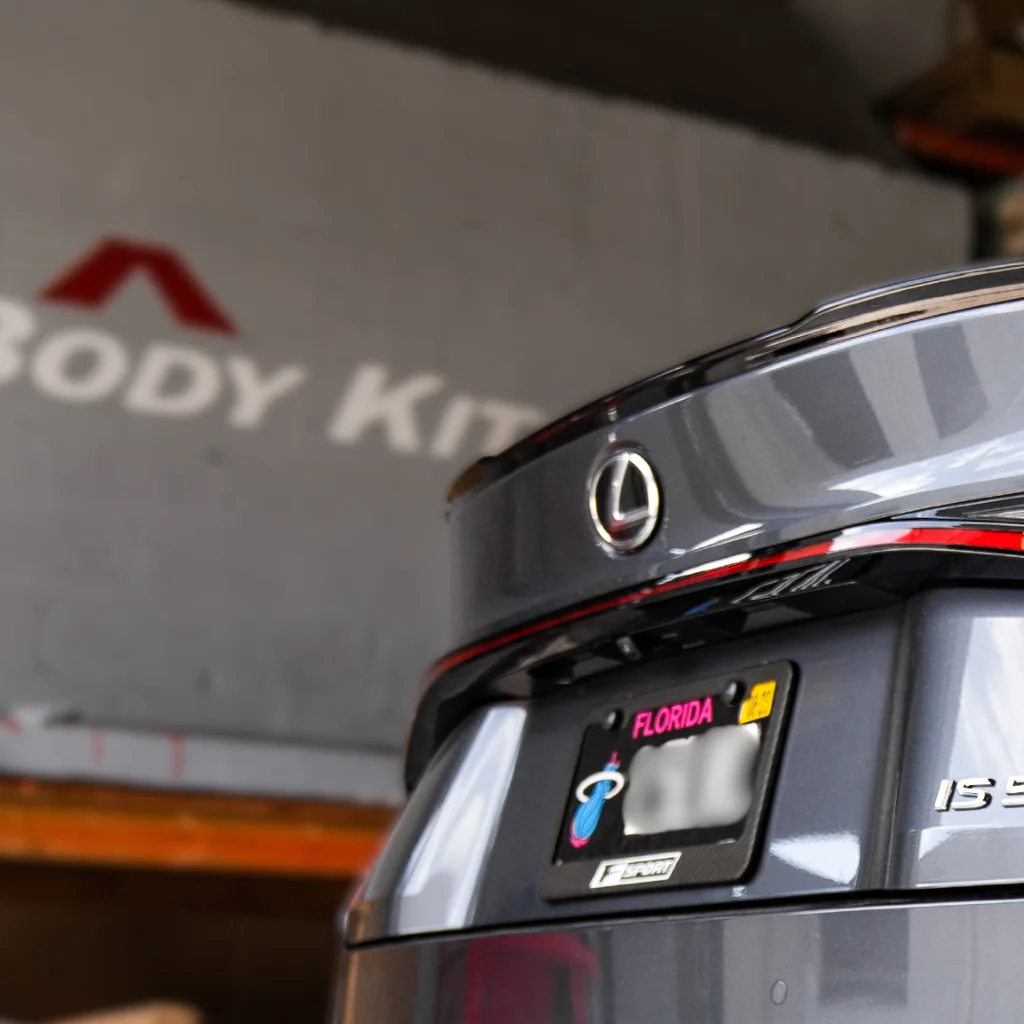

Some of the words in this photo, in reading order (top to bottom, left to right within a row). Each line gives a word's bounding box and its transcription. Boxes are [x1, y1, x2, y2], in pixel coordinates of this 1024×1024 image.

[632, 696, 713, 740] FLORIDA
[934, 776, 996, 812] IS
[621, 859, 674, 879] SPORT
